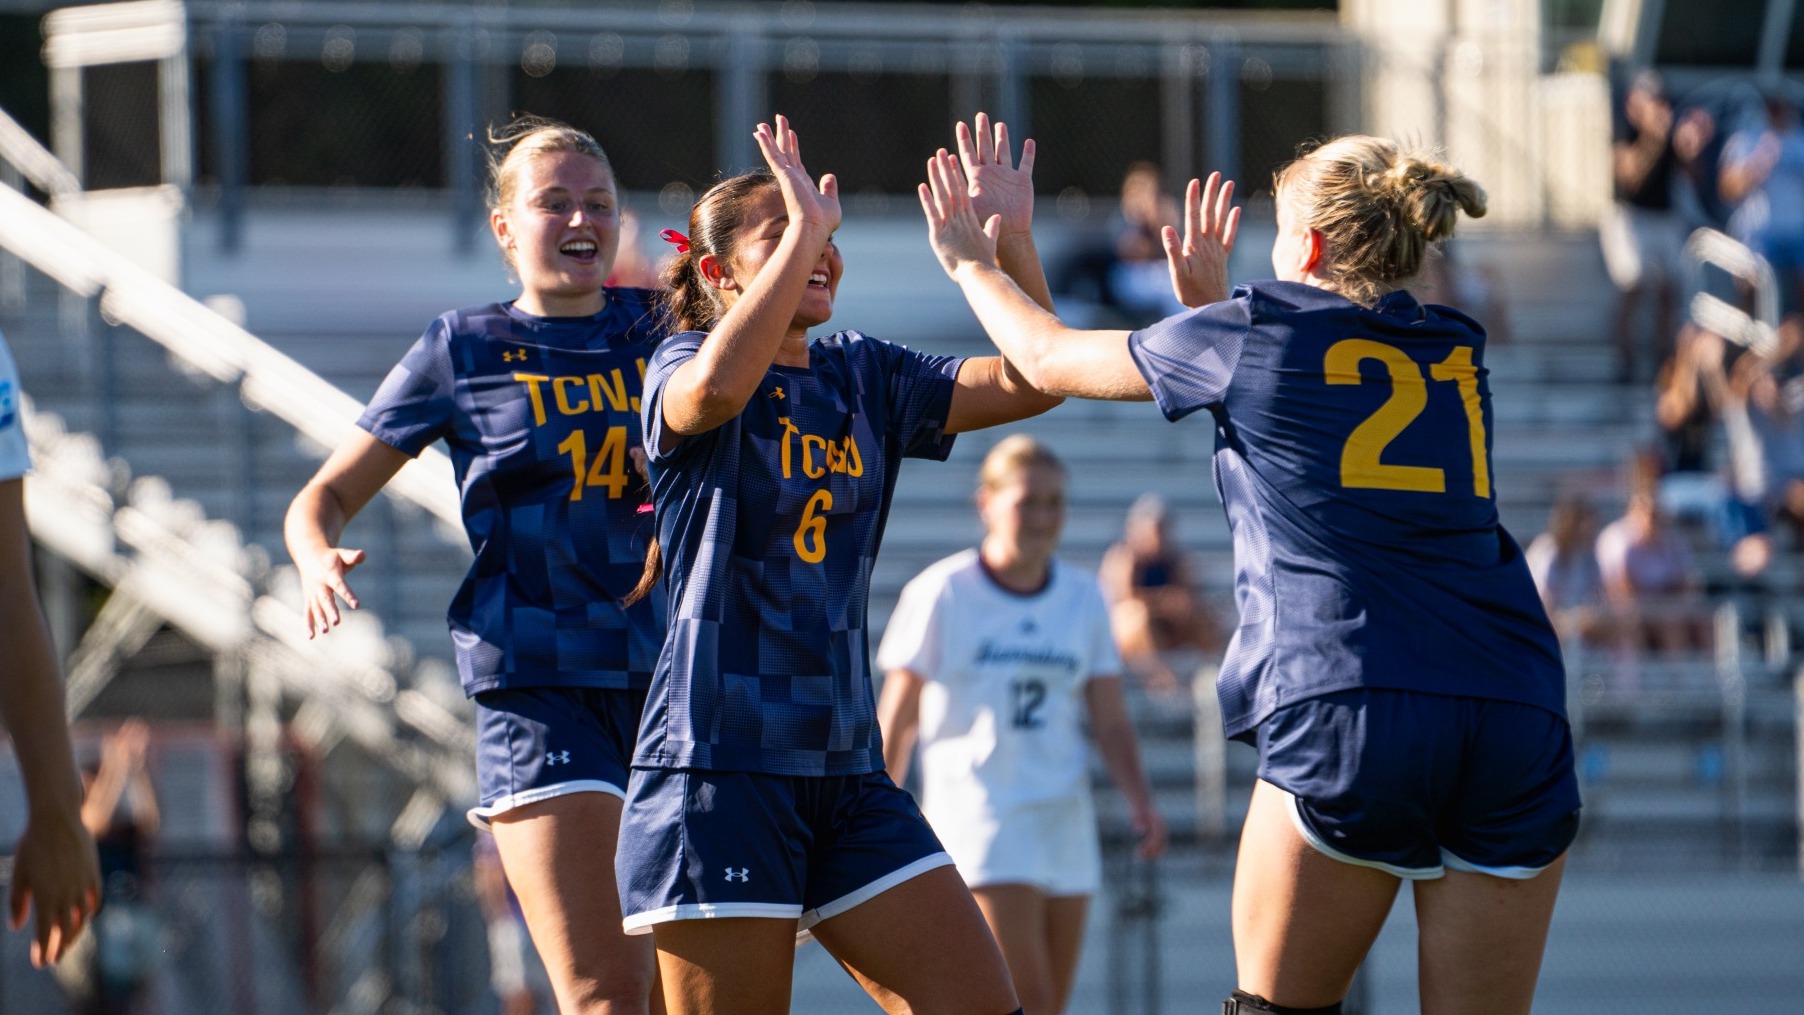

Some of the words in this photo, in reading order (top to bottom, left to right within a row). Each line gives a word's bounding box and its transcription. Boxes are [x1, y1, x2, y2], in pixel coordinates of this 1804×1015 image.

[513, 357, 647, 427] TCNJ
[1323, 338, 1490, 499] 21
[557, 426, 628, 501] 14
[793, 489, 833, 564] 6
[1011, 678, 1047, 729] 12
